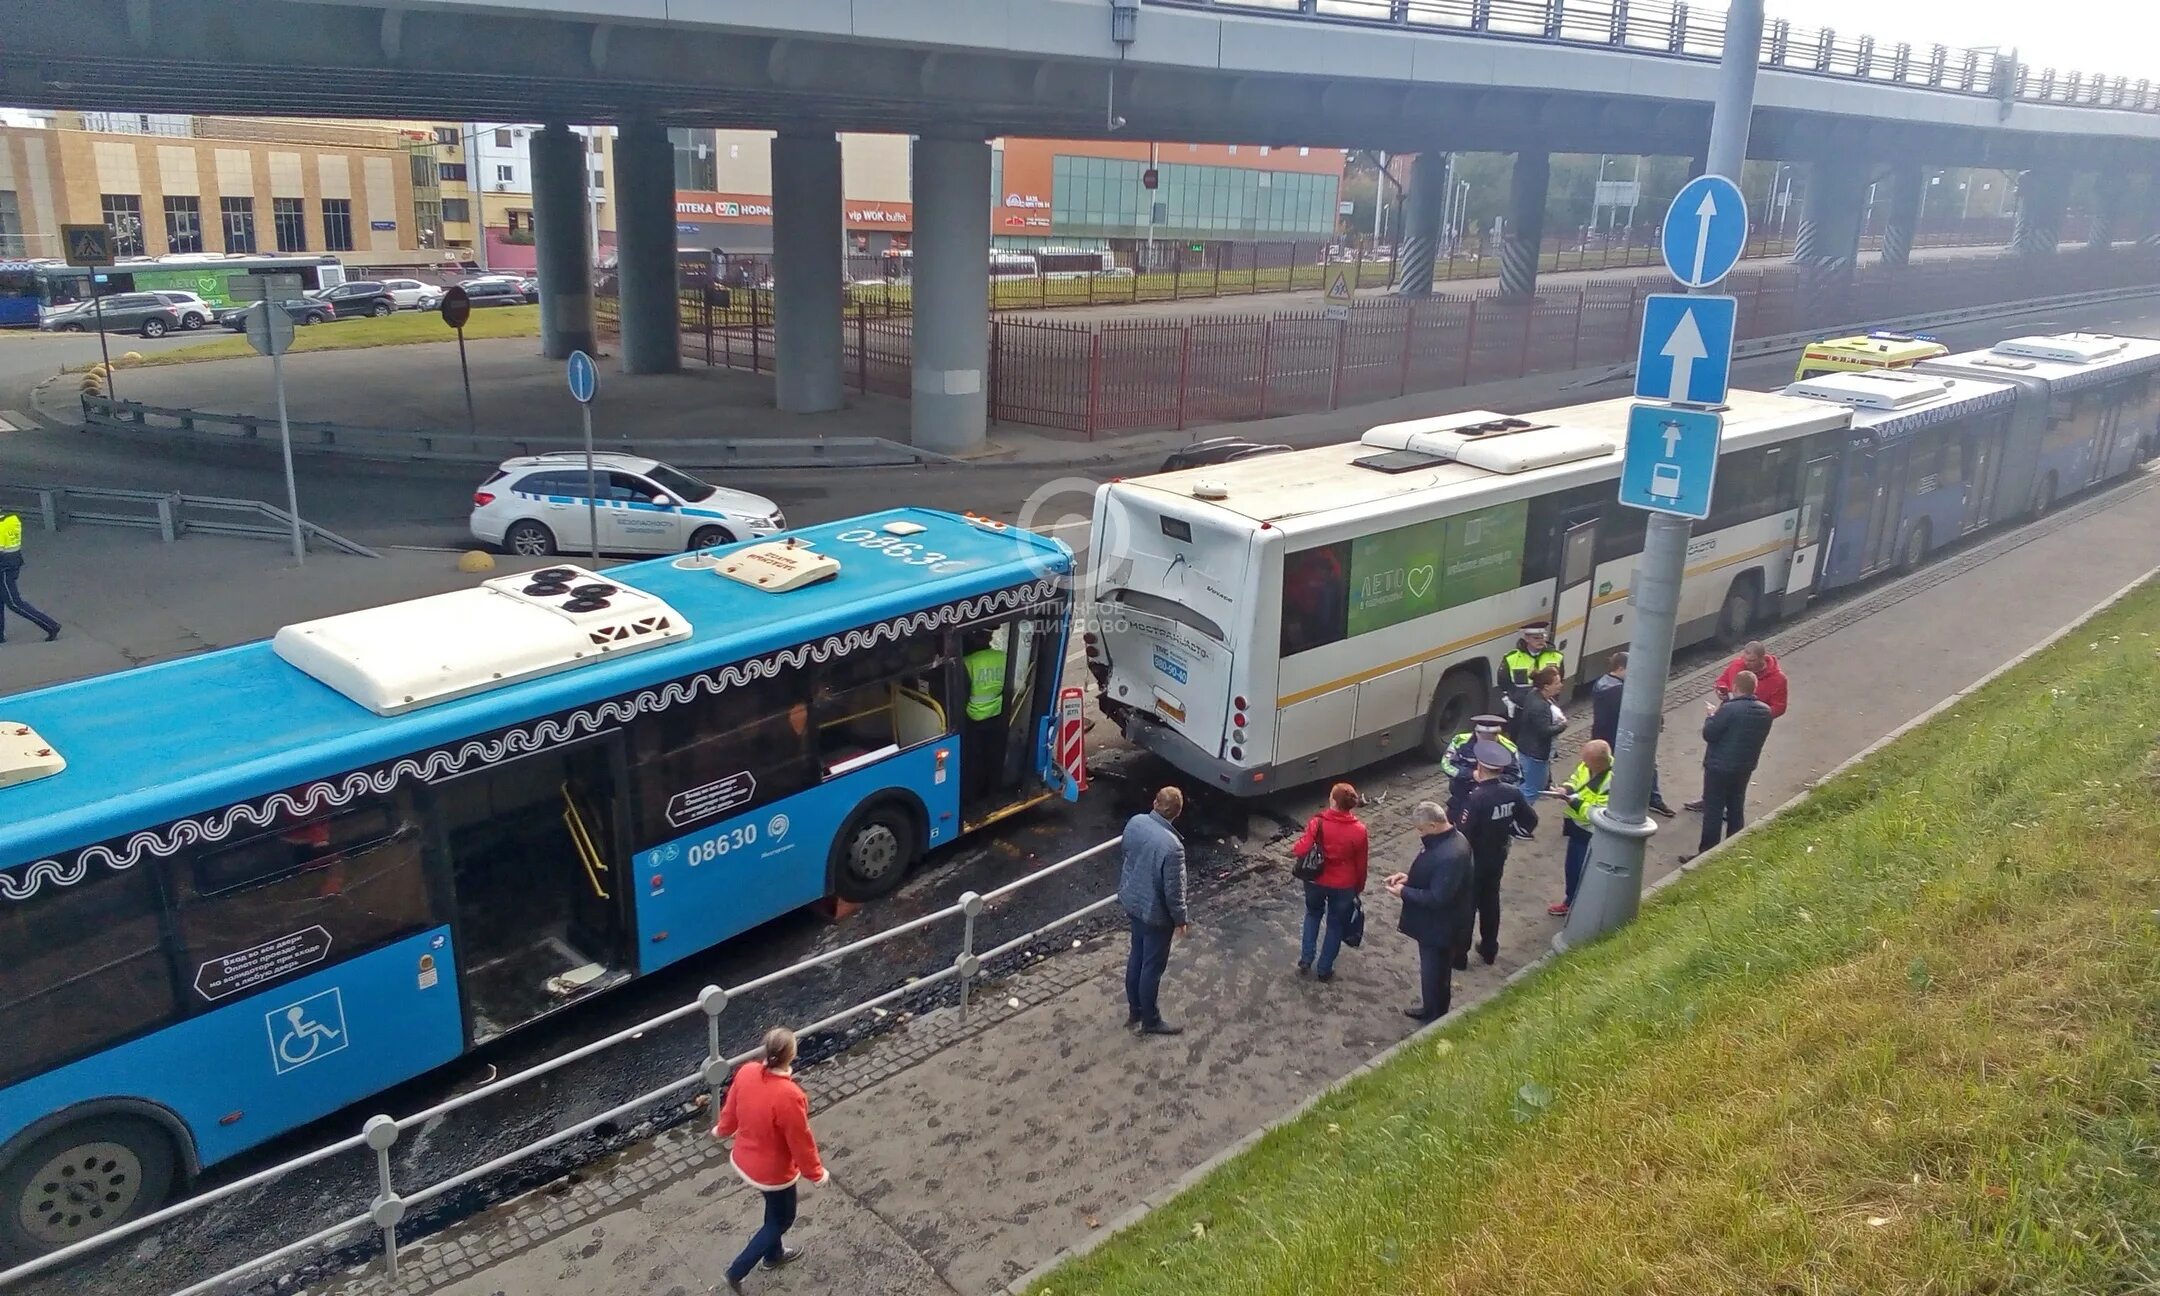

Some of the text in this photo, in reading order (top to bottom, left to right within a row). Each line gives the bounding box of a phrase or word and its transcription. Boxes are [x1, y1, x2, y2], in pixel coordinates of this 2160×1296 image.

[741, 205, 773, 216] НОРМ
[863, 210, 884, 221] WOK
[617, 518, 674, 527] БЕЗОПАСНОСТЬ
[1360, 567, 1405, 598] ЛЕТО
[688, 824, 757, 866] 08630
[223, 935, 302, 966] Вход во все двери
[294, 945, 320, 957] входе
[224, 959, 258, 974] Оплата
[260, 945, 296, 963] проезда
[274, 961, 299, 974] дверь
